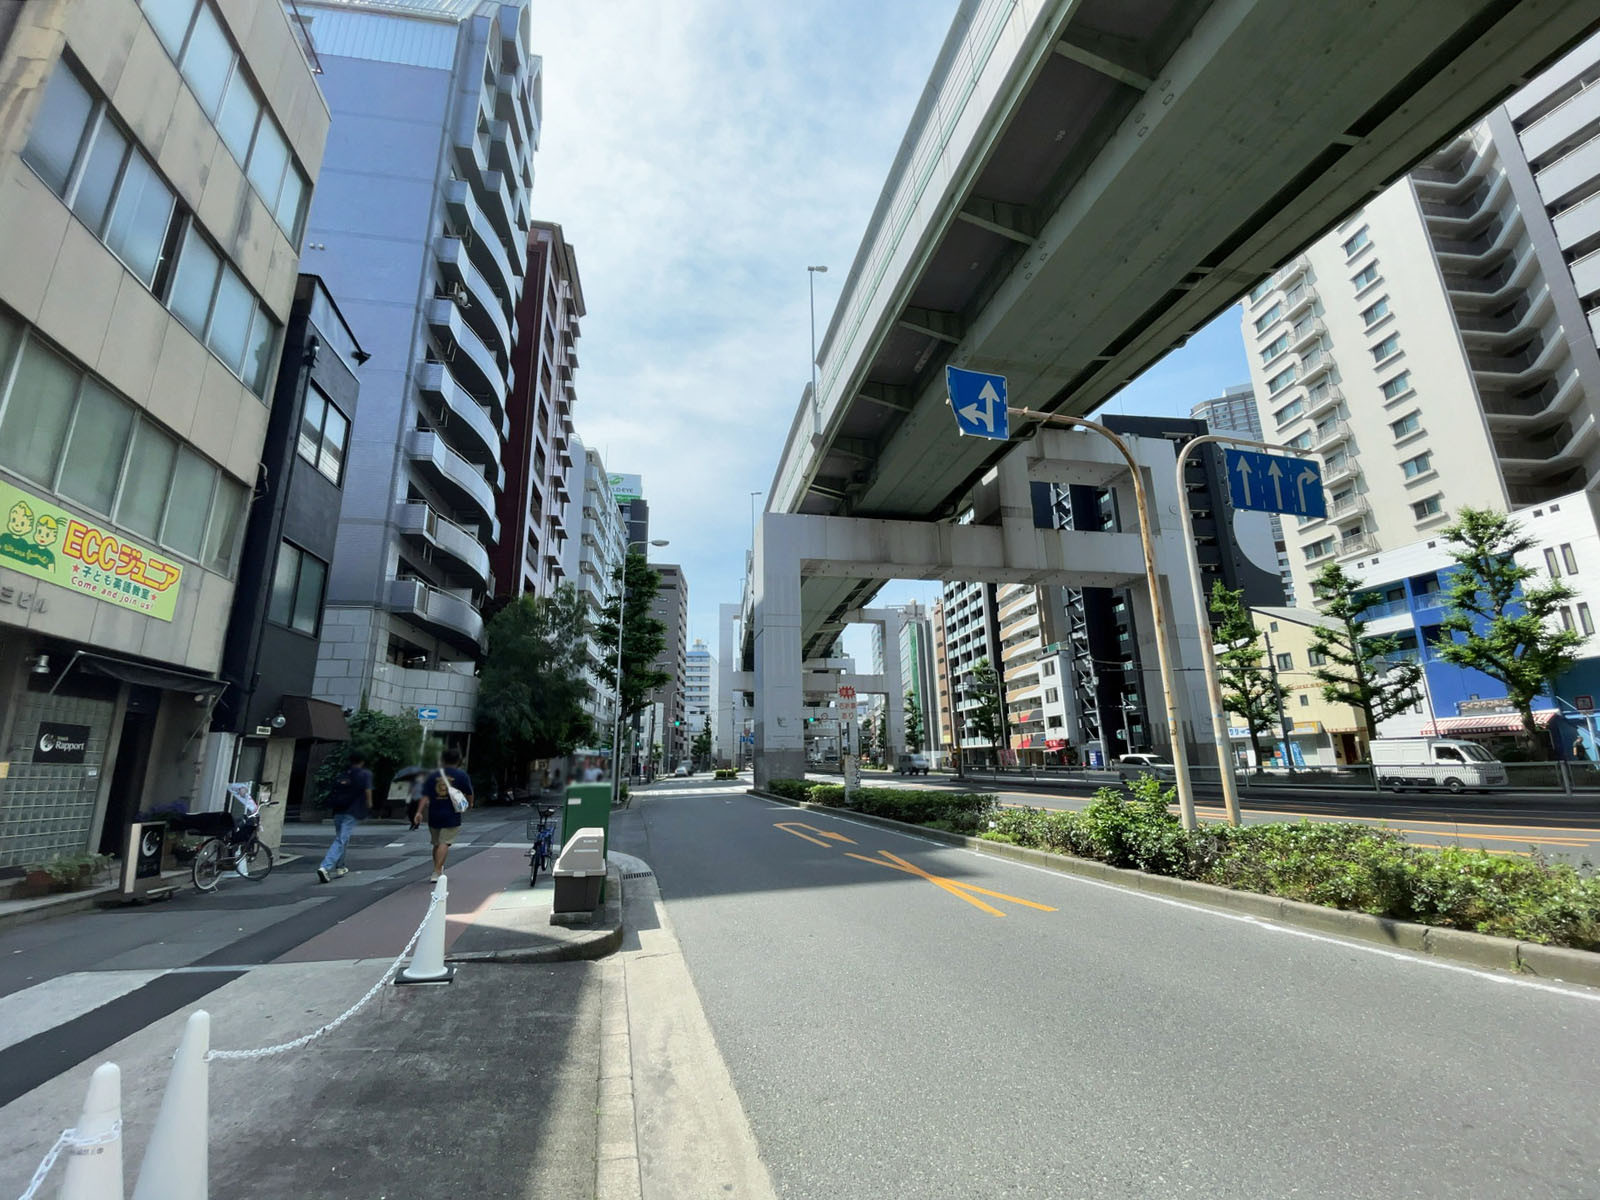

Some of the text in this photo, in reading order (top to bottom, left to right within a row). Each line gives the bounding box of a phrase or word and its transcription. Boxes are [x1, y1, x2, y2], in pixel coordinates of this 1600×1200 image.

[71, 576, 97, 592] Come
[101, 588, 118, 600] and
[119, 594, 138, 606] join
[55, 741, 85, 752] Rapport
